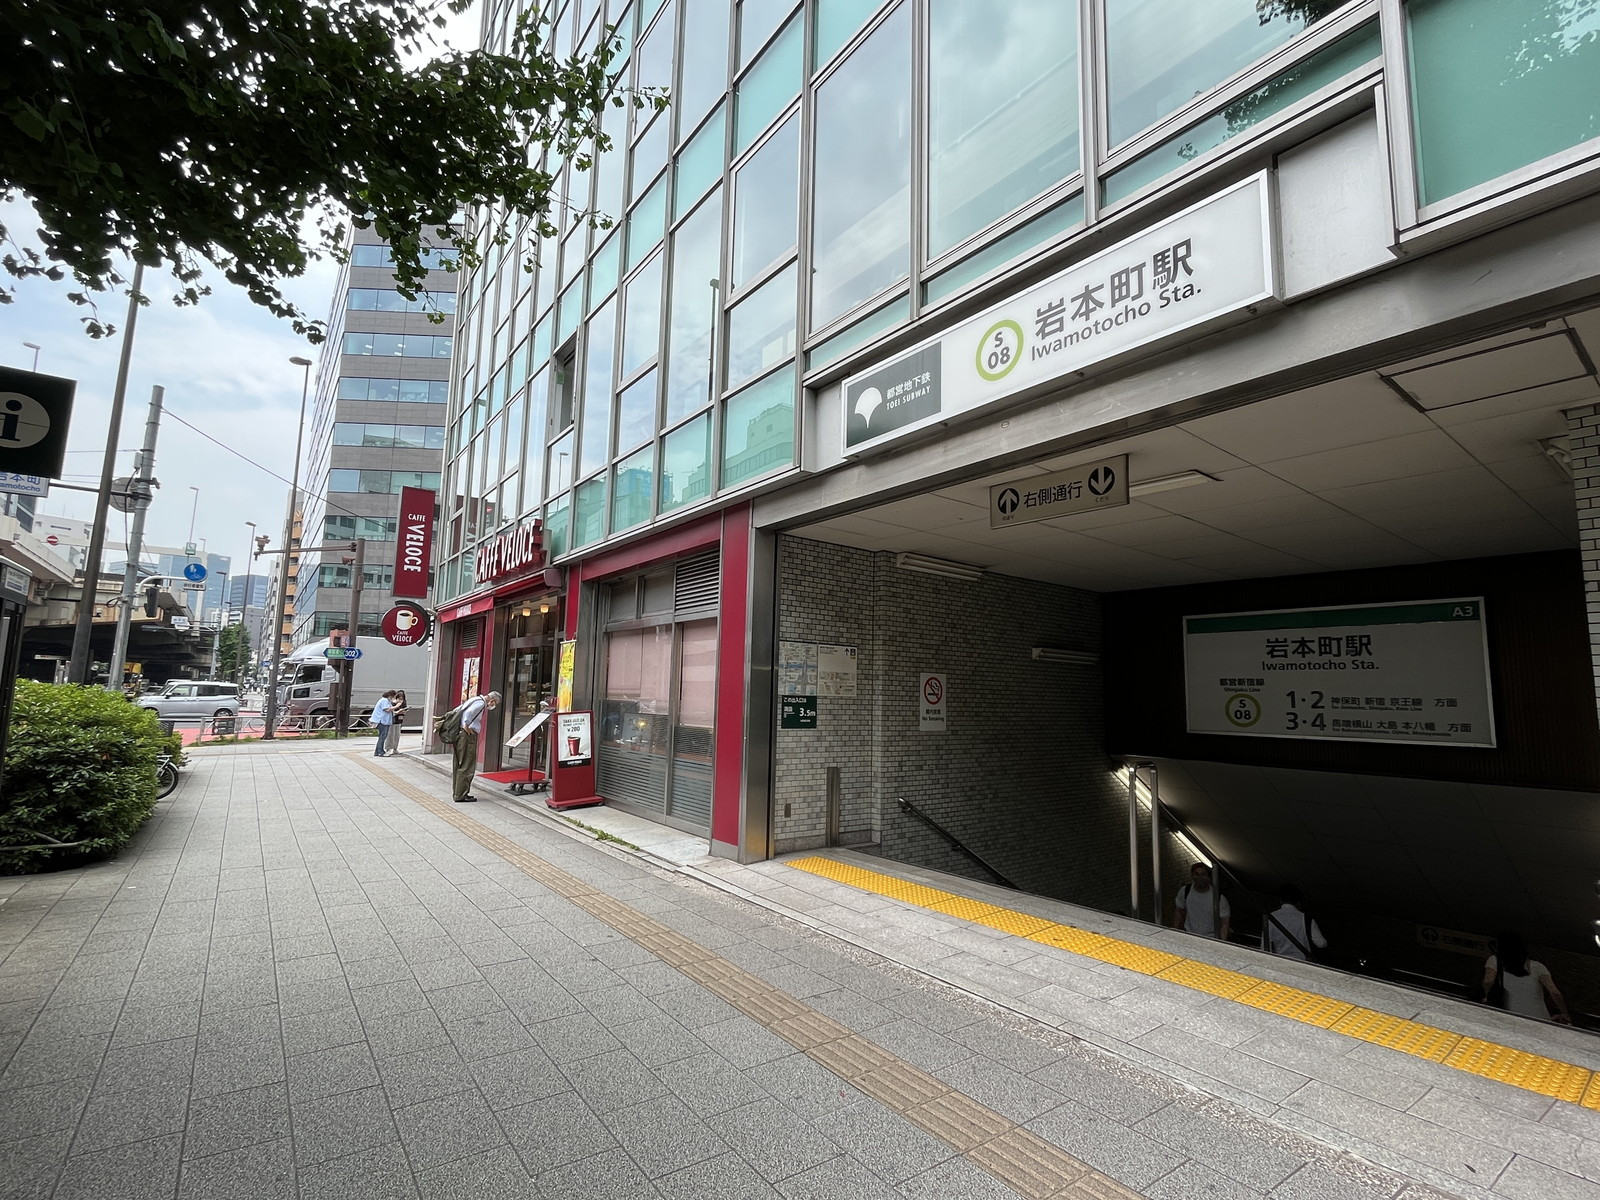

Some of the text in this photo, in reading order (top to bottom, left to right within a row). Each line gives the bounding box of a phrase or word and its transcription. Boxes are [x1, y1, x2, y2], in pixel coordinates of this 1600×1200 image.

[1034, 237, 1194, 341] 岩本町駅
[1032, 282, 1202, 362] Iwamotocho Sta.
[994, 331, 1003, 348] S
[987, 346, 1010, 370] 08
[886, 371, 931, 400] 都営地下鉄
[886, 385, 931, 411] TOEI SUBWAY
[1023, 480, 1083, 509] 右側通行
[408, 513, 426, 522] CAFFE
[403, 524, 425, 573] VELOCE
[475, 519, 535, 583] CAFFE VELOCE
[1452, 605, 1474, 617] A3
[391, 634, 413, 643] VELOCE
[1265, 634, 1373, 659] 岩本町駅
[1262, 659, 1380, 671] Iwamotocho Sta.
[1238, 699, 1246, 708] S
[1331, 697, 1360, 706] 神保町
[1365, 697, 1386, 706] 新宿
[1390, 697, 1423, 707] 京王線
[1434, 698, 1458, 707] 方面
[799, 707, 816, 717] 3.5m
[1234, 709, 1251, 720] 08
[1376, 721, 1398, 729] 大島
[1402, 721, 1435, 731] 本八幡
[1448, 723, 1472, 732] 方面
